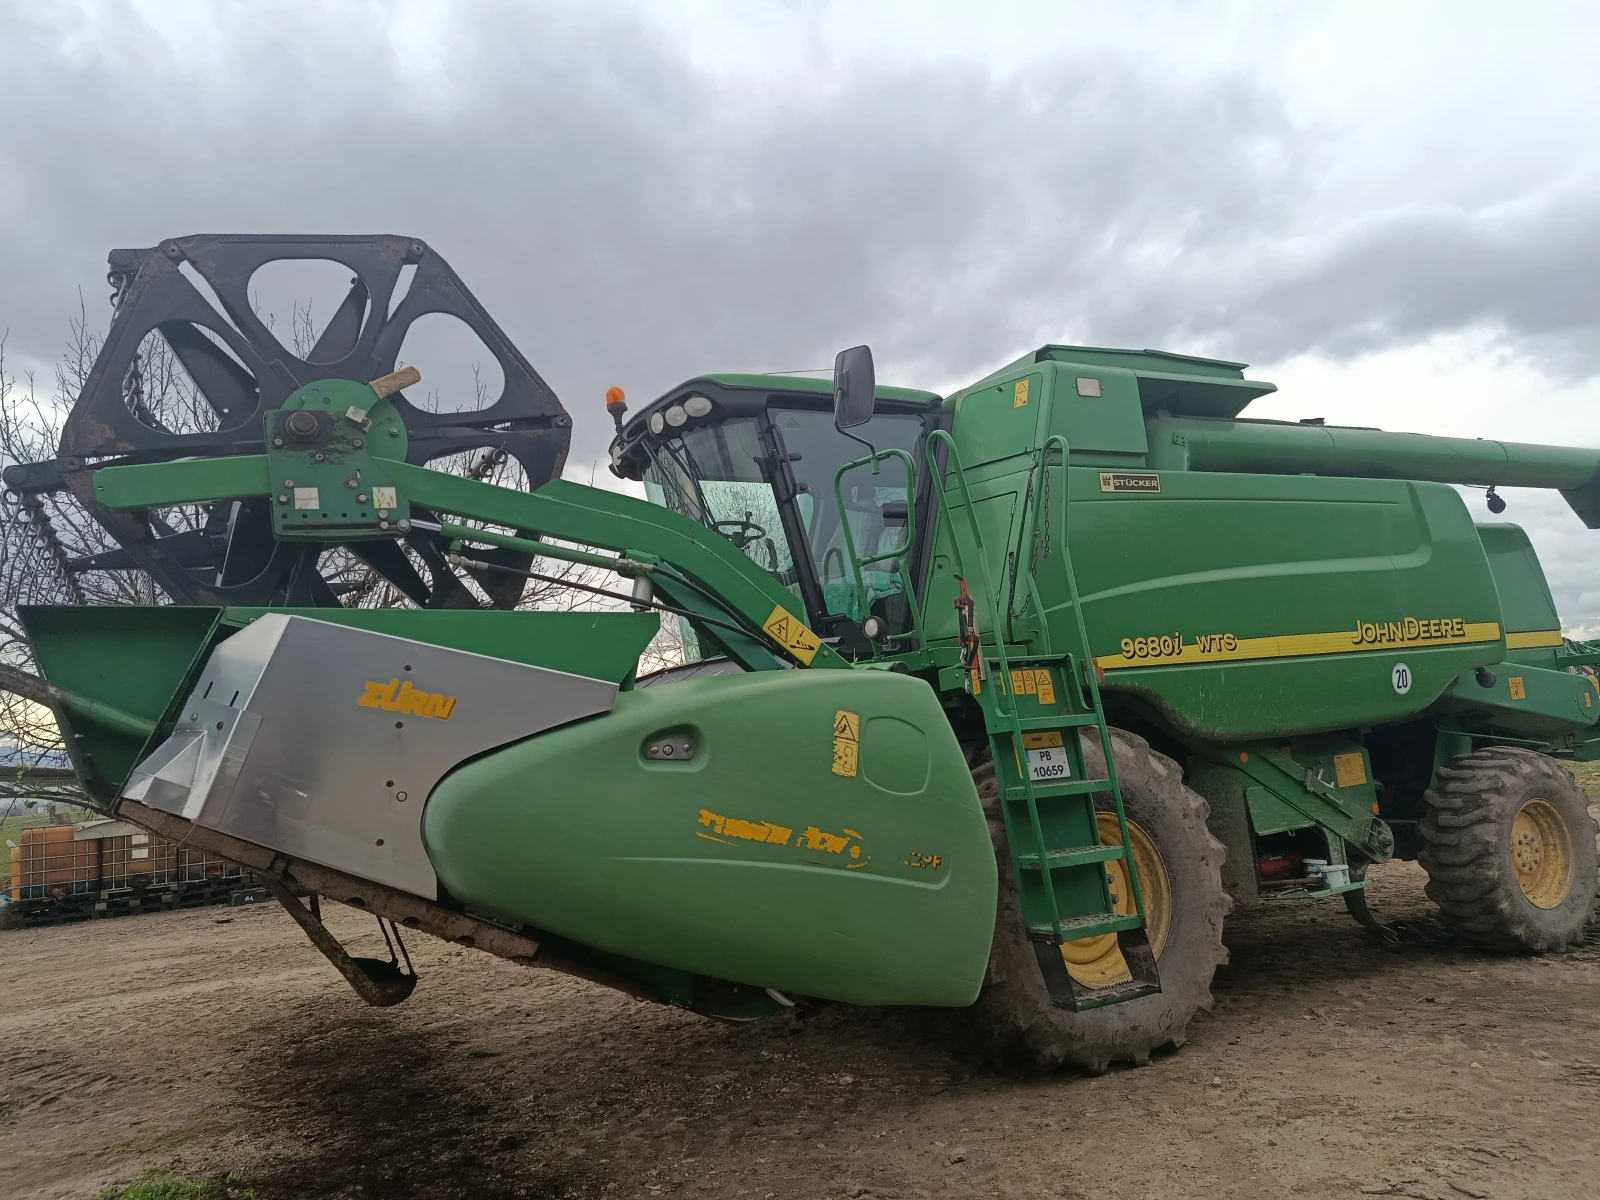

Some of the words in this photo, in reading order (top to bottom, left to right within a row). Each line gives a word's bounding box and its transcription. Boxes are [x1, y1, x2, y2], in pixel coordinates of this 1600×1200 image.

[1113, 478, 1158, 487] STÜCKER
[1120, 631, 1183, 660] 9680i
[1195, 633, 1238, 653] WTS
[1395, 668, 1408, 689] 20
[1039, 750, 1052, 762] PB
[1033, 764, 1064, 777] 10659
